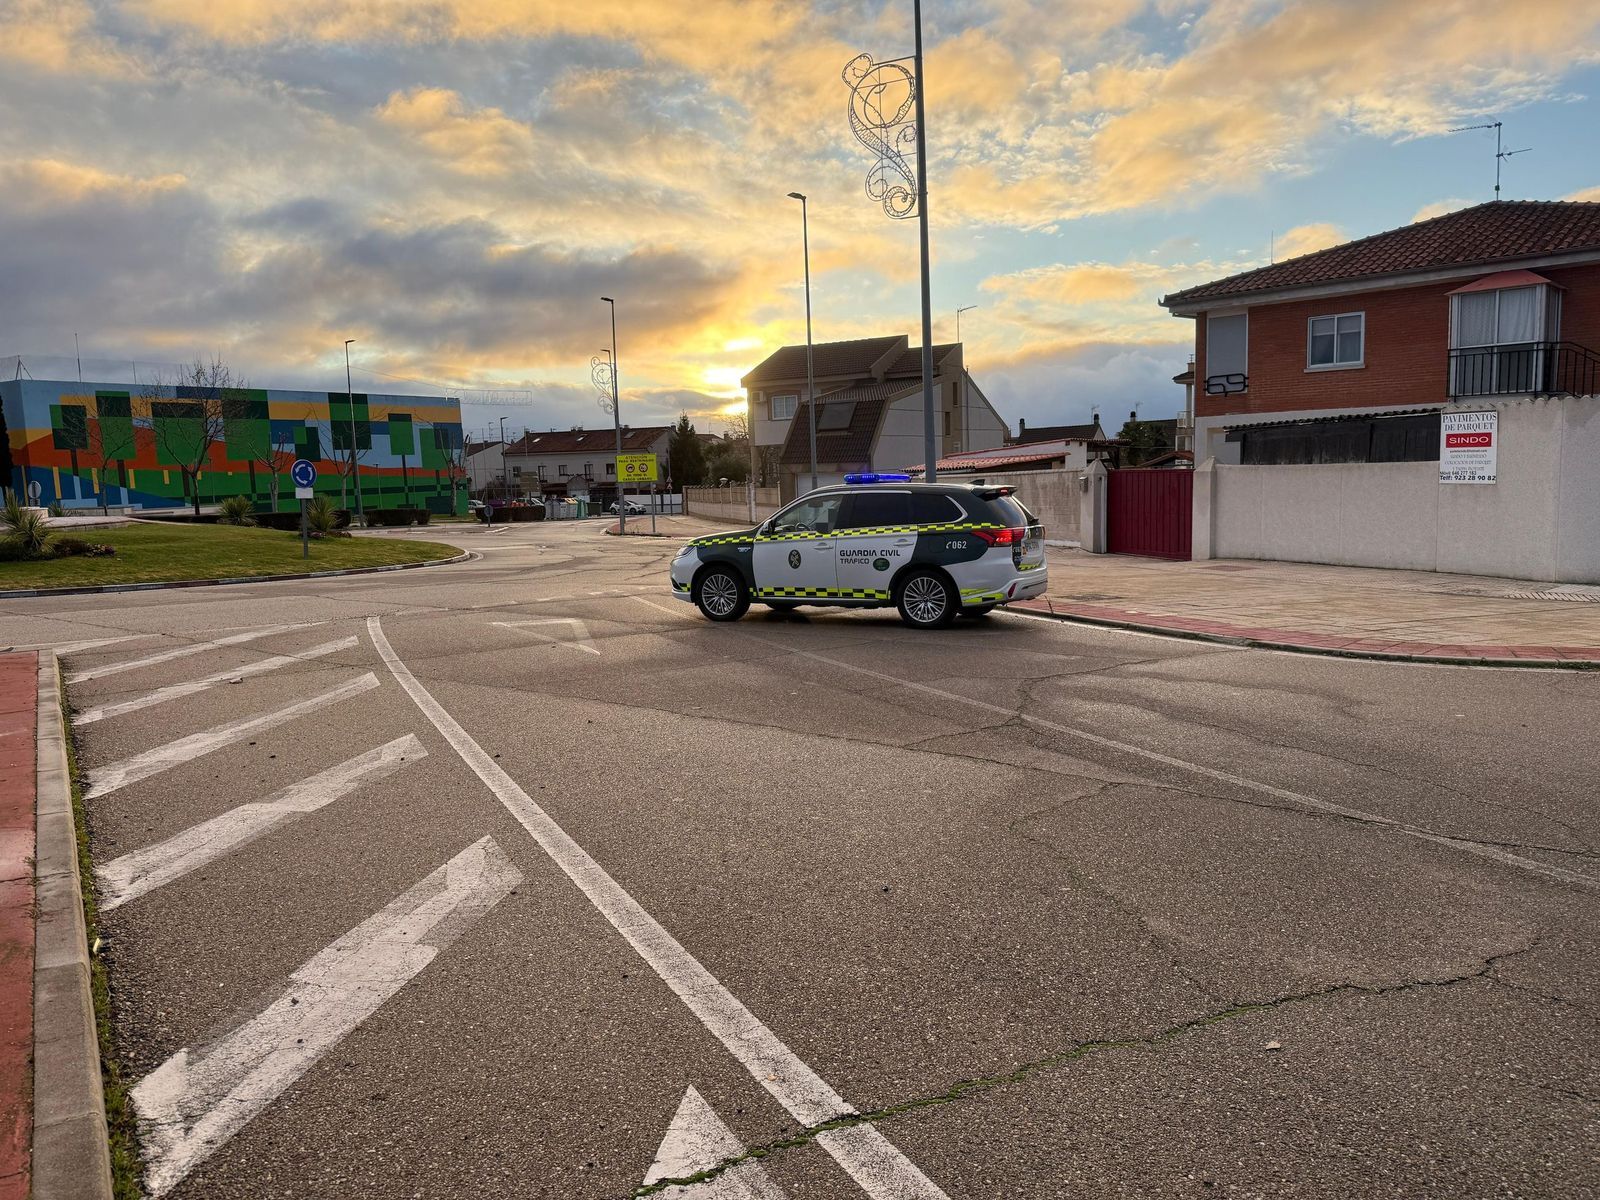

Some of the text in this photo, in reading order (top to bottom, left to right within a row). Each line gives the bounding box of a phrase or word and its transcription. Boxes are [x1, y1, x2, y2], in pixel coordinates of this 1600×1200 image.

[1442, 413, 1496, 423] PAVIMENTOS
[1444, 422, 1494, 432] DE PARQUET
[952, 540, 967, 550] 062
[840, 549, 900, 557] GUARDIA CIVIL
